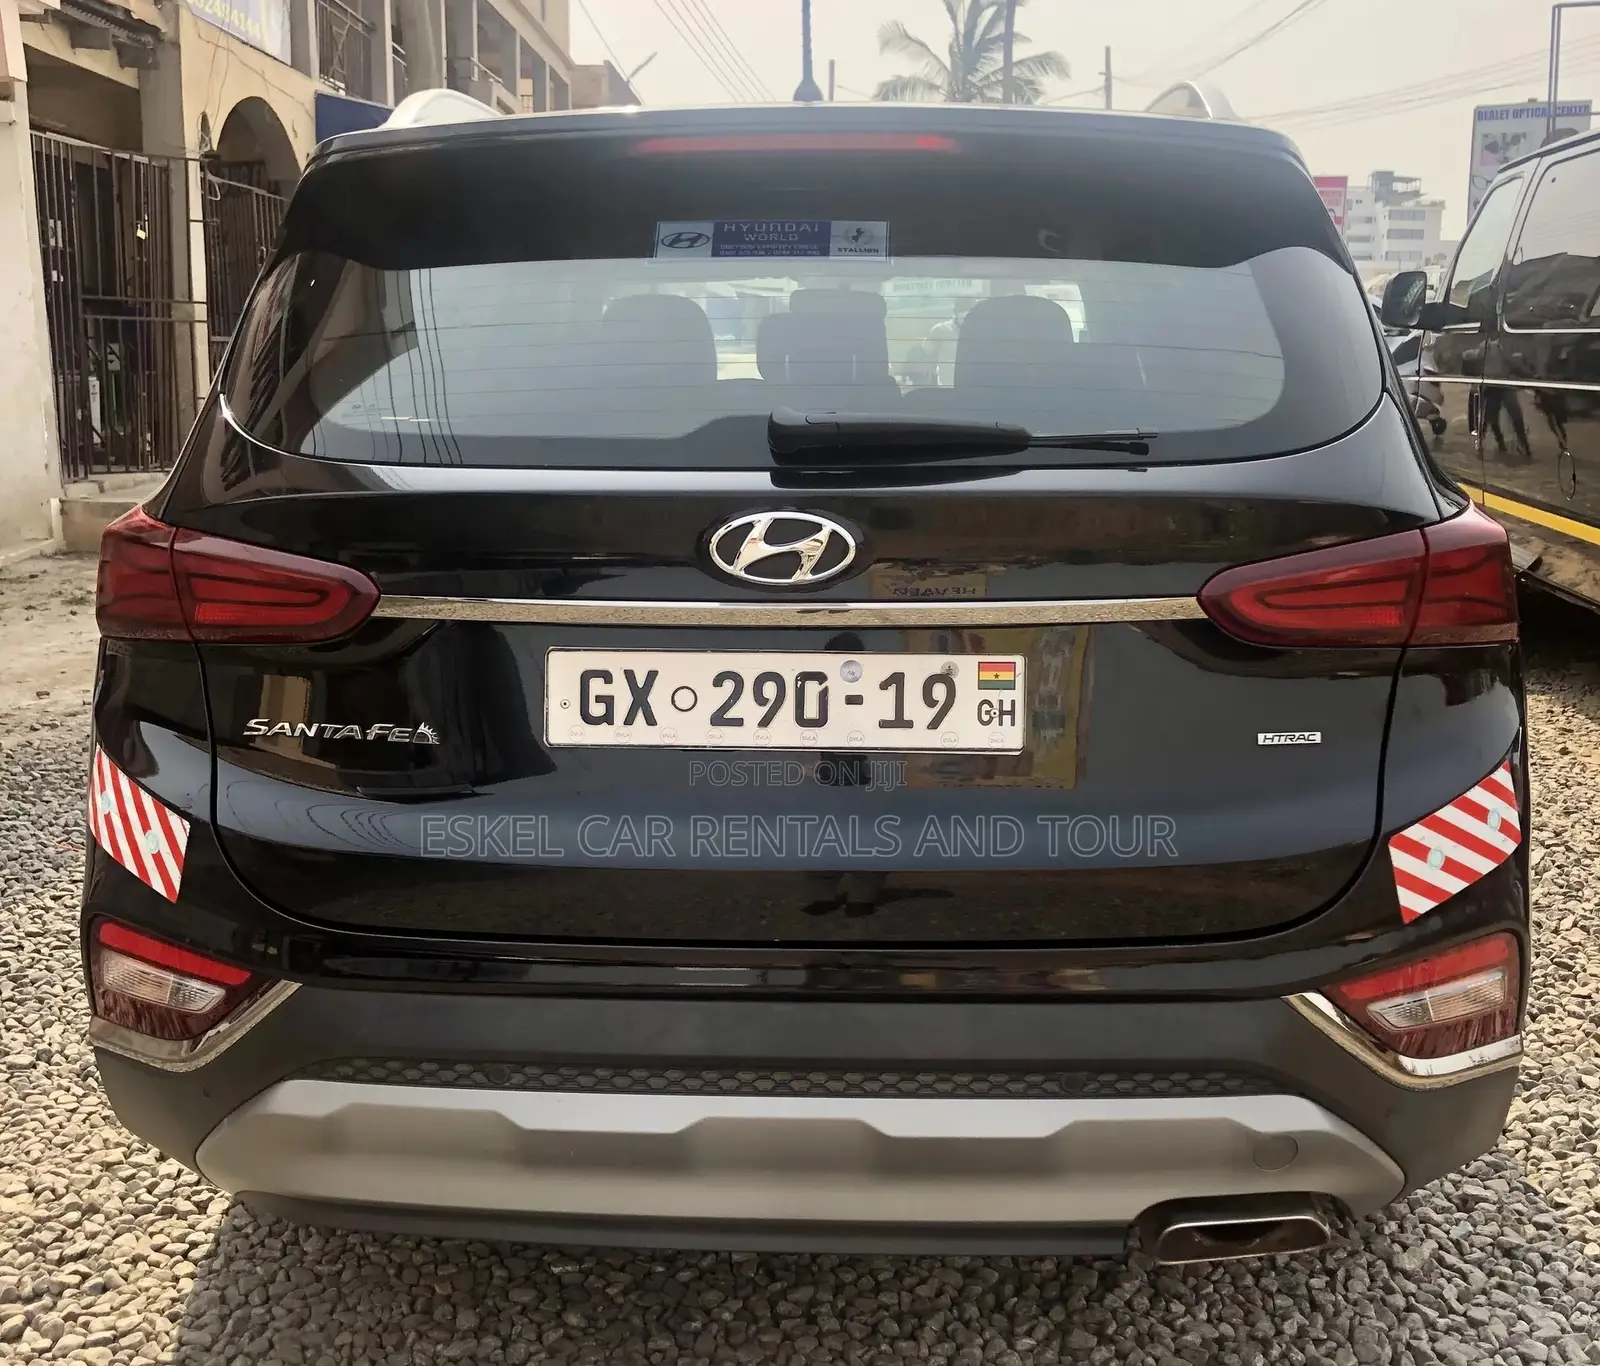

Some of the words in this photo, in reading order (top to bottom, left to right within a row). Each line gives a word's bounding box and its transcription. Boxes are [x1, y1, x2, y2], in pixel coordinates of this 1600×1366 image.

[1512, 107, 1549, 120] OPTICA
[723, 223, 819, 233] HYUNDAI
[744, 233, 799, 241] WORLD
[579, 669, 659, 727] GX
[976, 698, 1016, 727] GH
[1263, 733, 1317, 743] HTRAC
